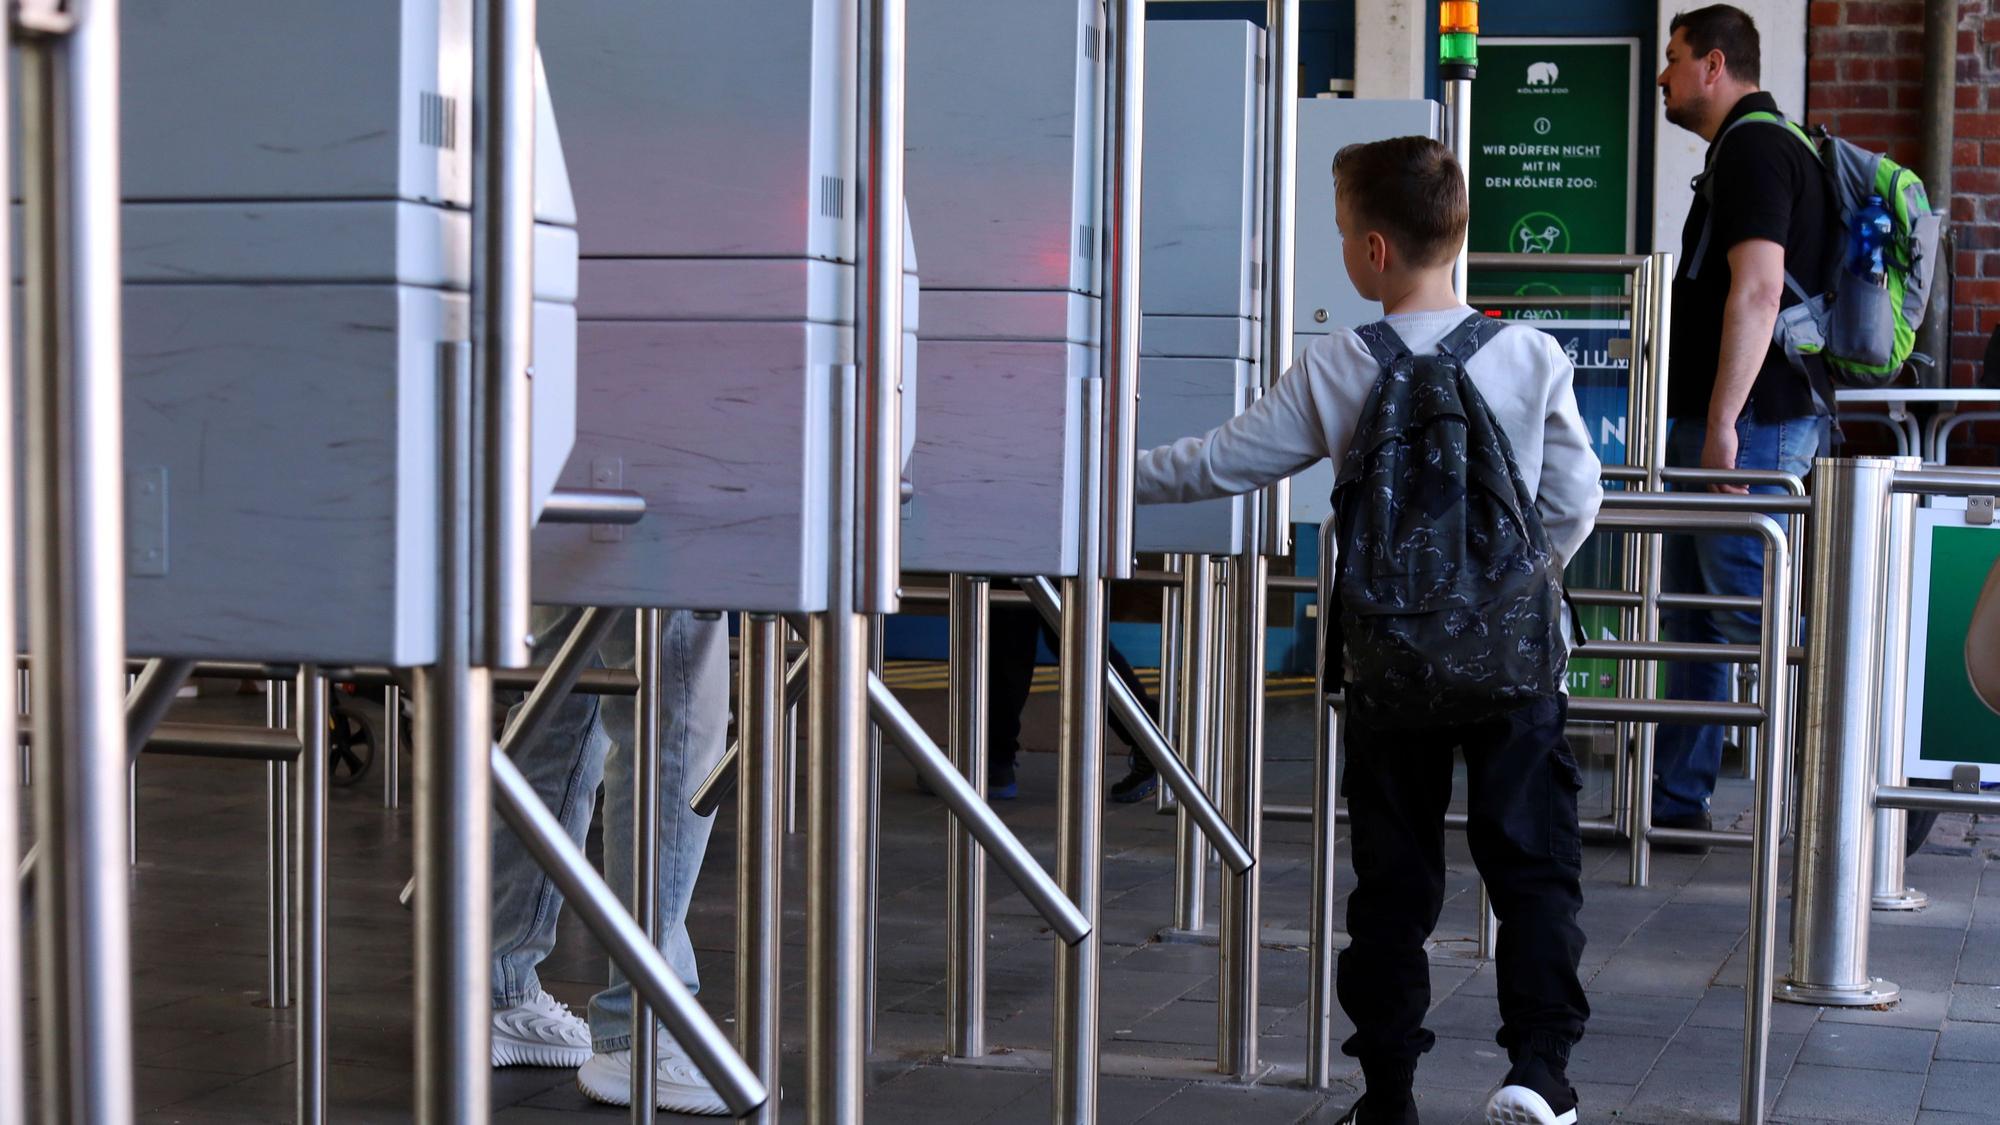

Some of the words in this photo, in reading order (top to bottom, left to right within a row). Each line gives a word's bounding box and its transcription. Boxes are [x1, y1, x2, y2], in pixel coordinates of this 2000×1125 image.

[1482, 145, 1506, 155] WIR
[1509, 143, 1559, 155] DÜRFEN
[1562, 145, 1601, 157] NICHT
[1522, 161, 1544, 171] MIT
[1547, 161, 1561, 171] IN
[1485, 177, 1511, 187] DEN
[1514, 175, 1563, 188] KÖLNER
[1566, 178, 1597, 188] ZOO:
